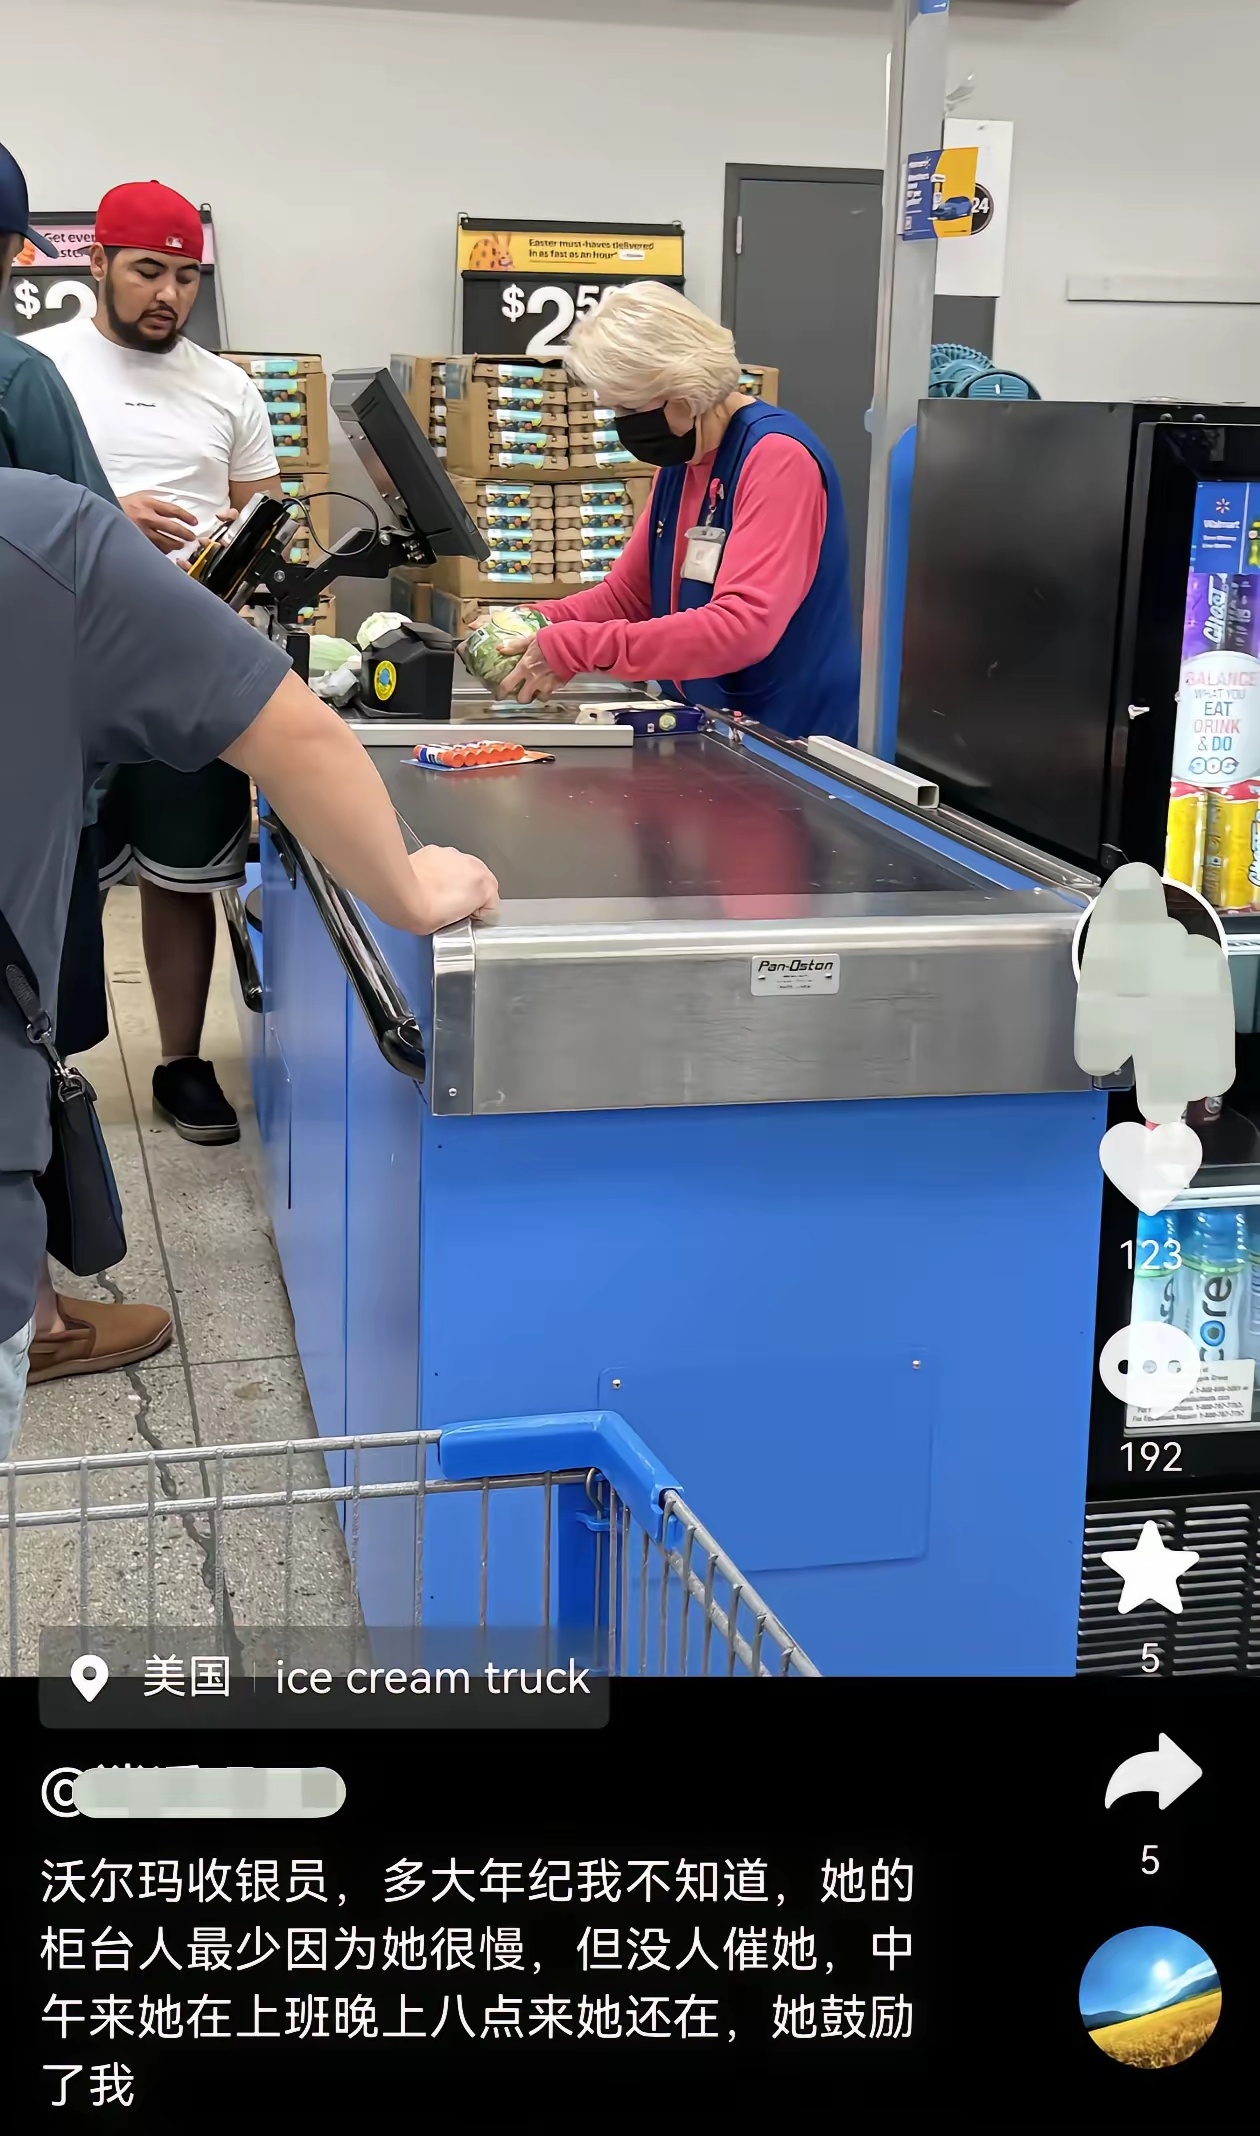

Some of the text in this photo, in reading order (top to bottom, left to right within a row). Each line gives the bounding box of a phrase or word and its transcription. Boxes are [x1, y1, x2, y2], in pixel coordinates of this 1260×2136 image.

[529, 238, 557, 247] Easter
[550, 250, 567, 258] fast
[1185, 672, 1257, 686] BALANCE
[1227, 689, 1246, 699] YOU
[1204, 701, 1233, 716] EAT
[1194, 719, 1240, 734] DRINK
[1198, 736, 1233, 751] & DO
[758, 959, 833, 972] Pan-Oston
